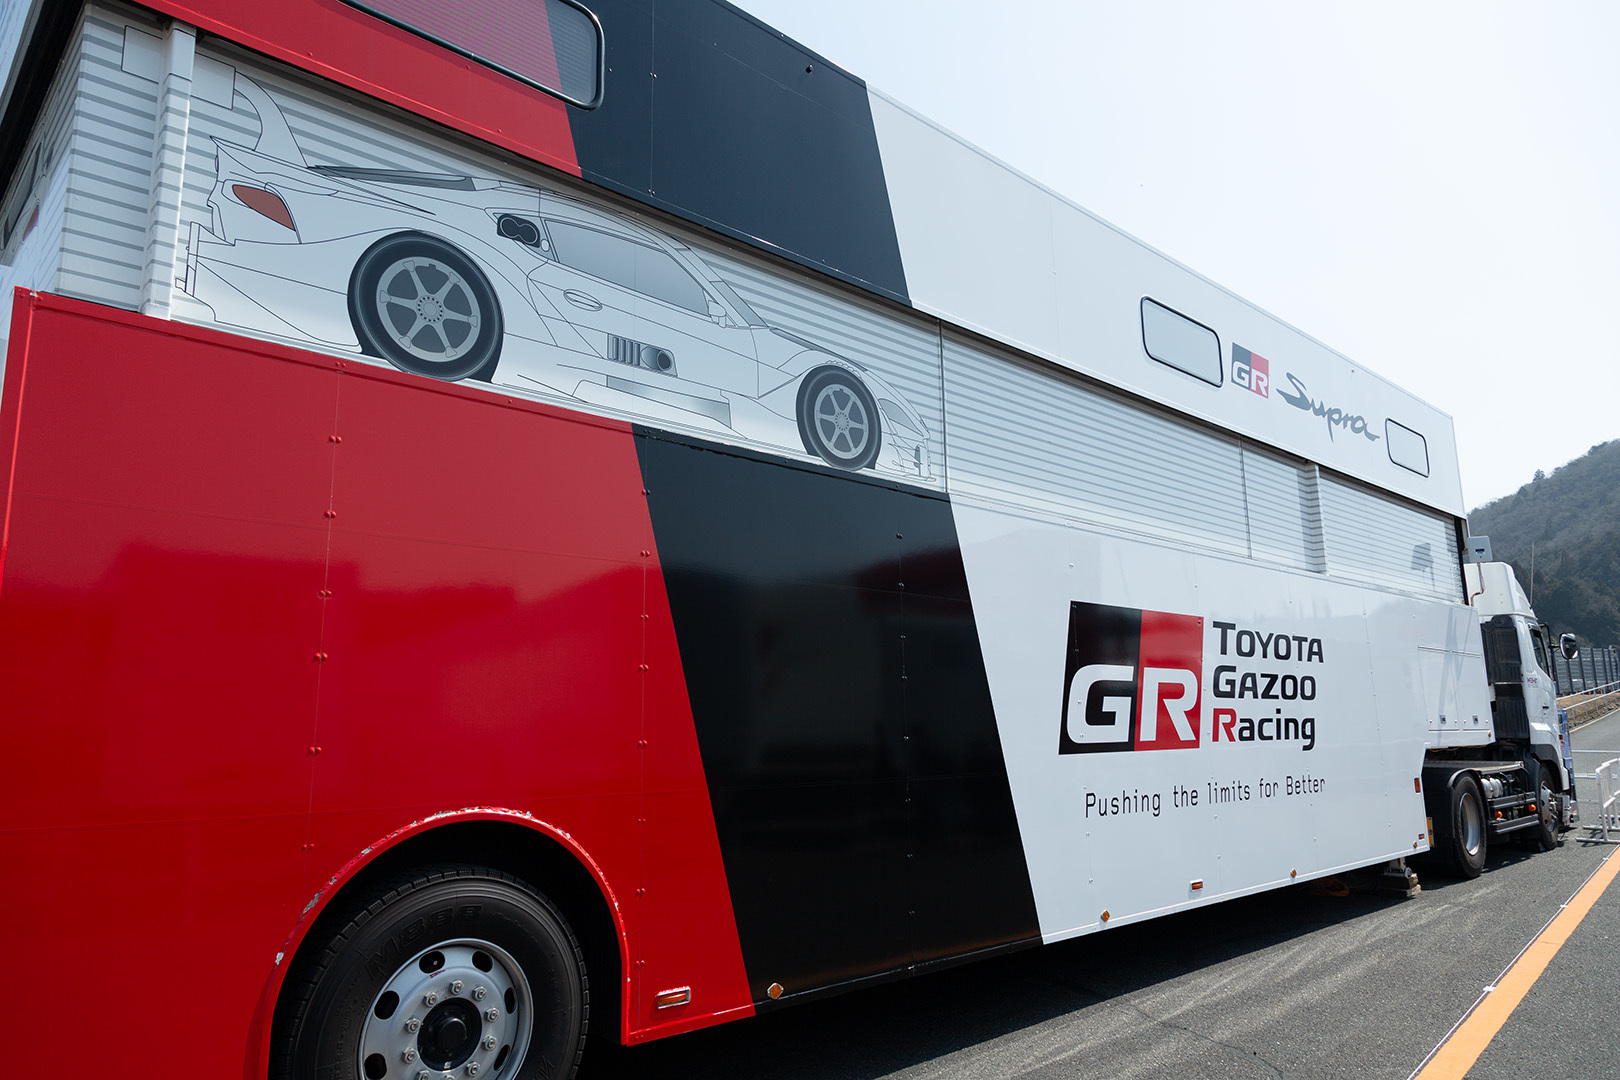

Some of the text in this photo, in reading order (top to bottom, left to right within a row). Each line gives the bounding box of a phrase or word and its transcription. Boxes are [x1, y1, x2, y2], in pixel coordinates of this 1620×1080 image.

[1233, 361, 1380, 443] GR Supra
[1212, 621, 1324, 663] TOYOTA
[1067, 665, 1198, 743] GR
[1212, 665, 1316, 700] GAZOO
[1212, 708, 1316, 751] Racing
[1085, 775, 1326, 818] Pushing the limits for Better
